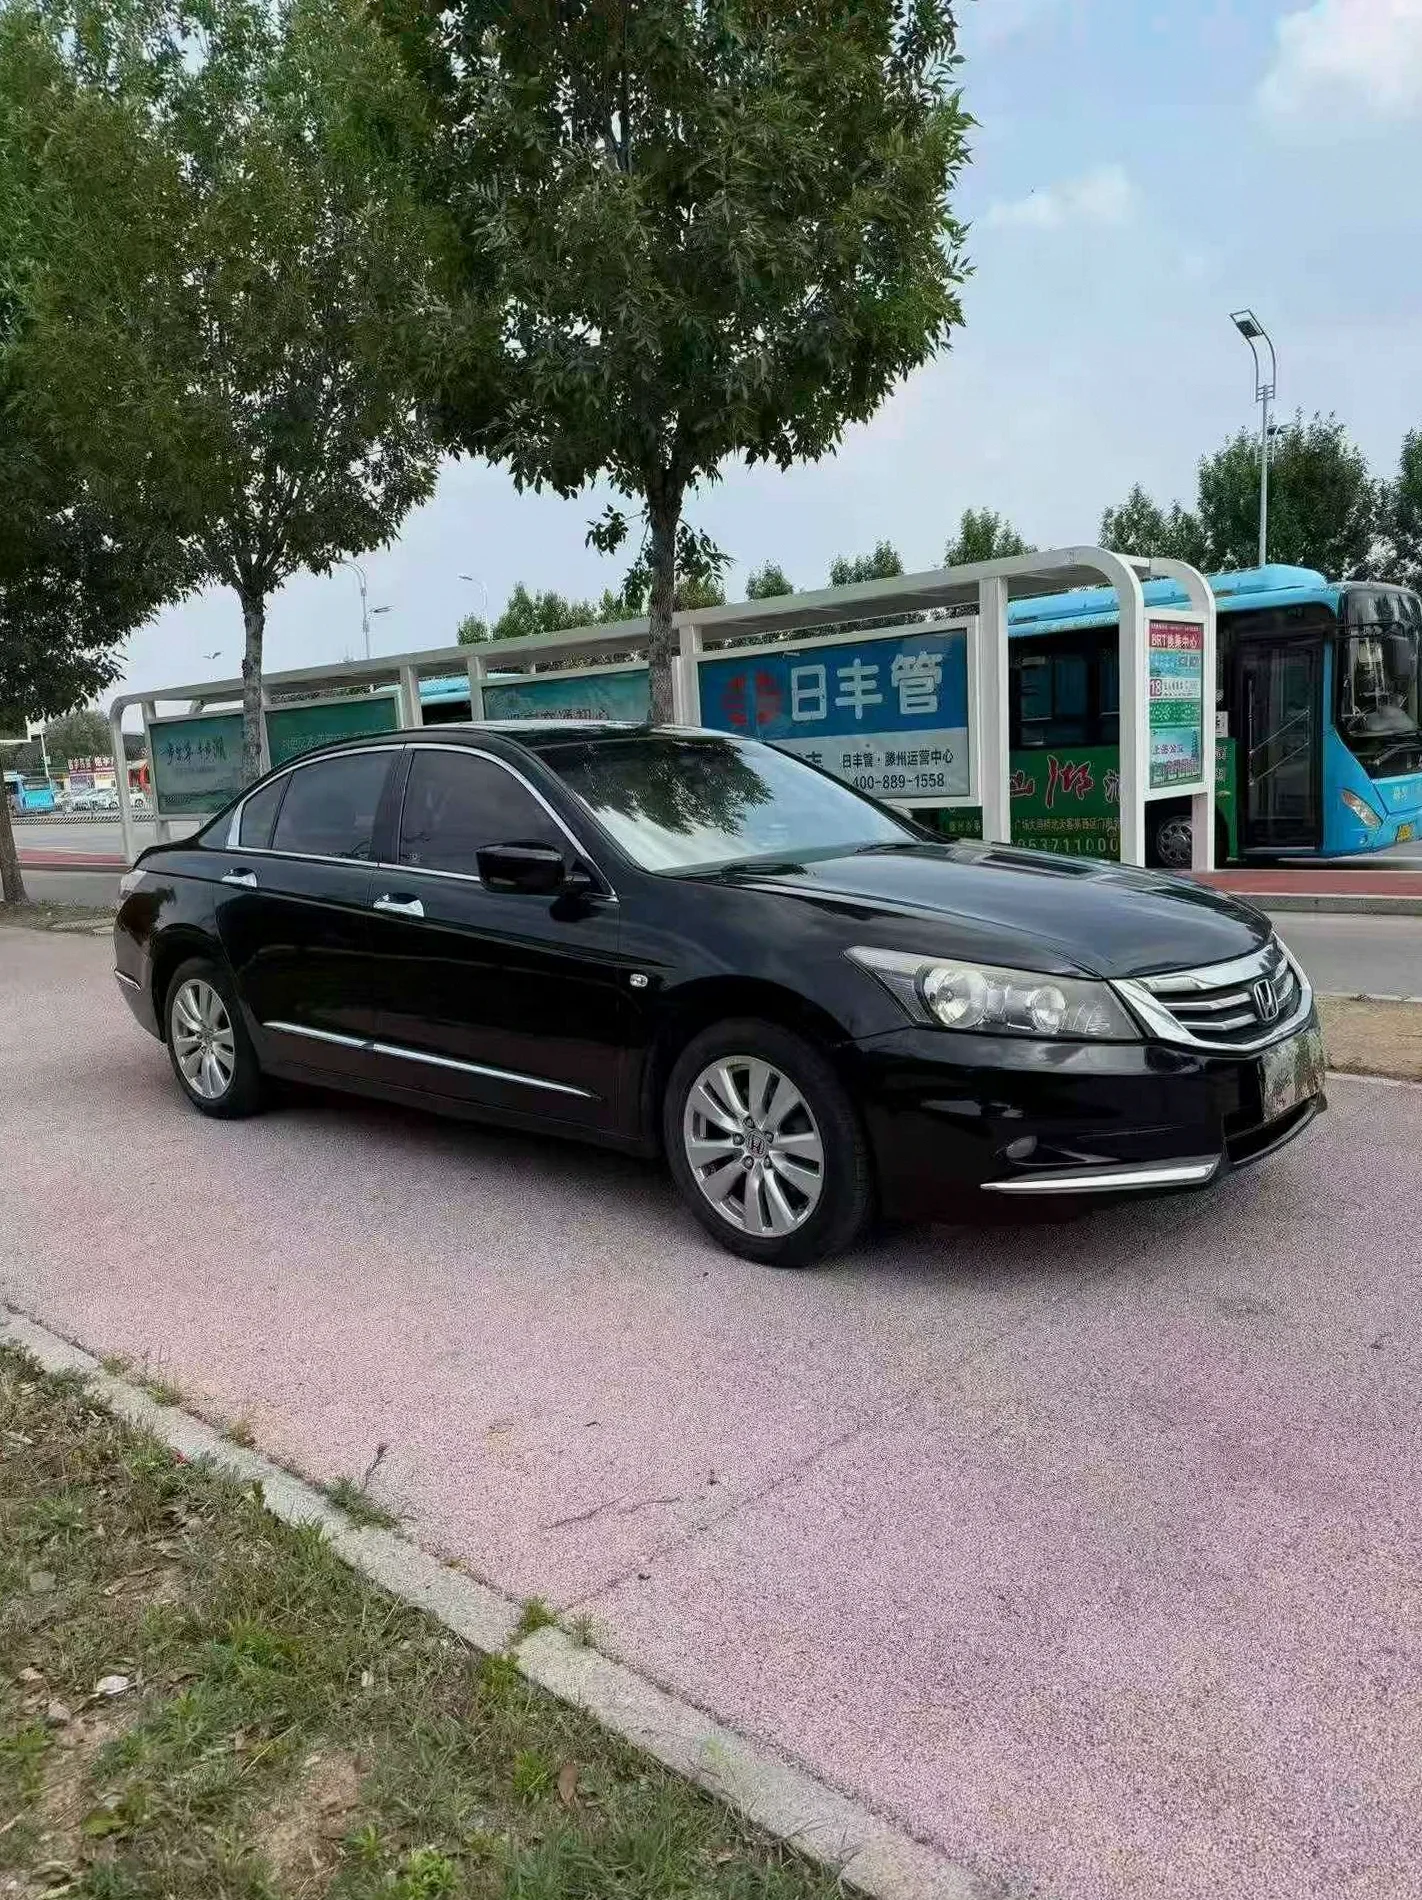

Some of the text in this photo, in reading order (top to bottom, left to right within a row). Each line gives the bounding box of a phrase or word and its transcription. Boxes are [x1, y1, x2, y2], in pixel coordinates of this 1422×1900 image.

[791, 651, 944, 721] 日丰管
[853, 773, 945, 790] 400-889-1558
